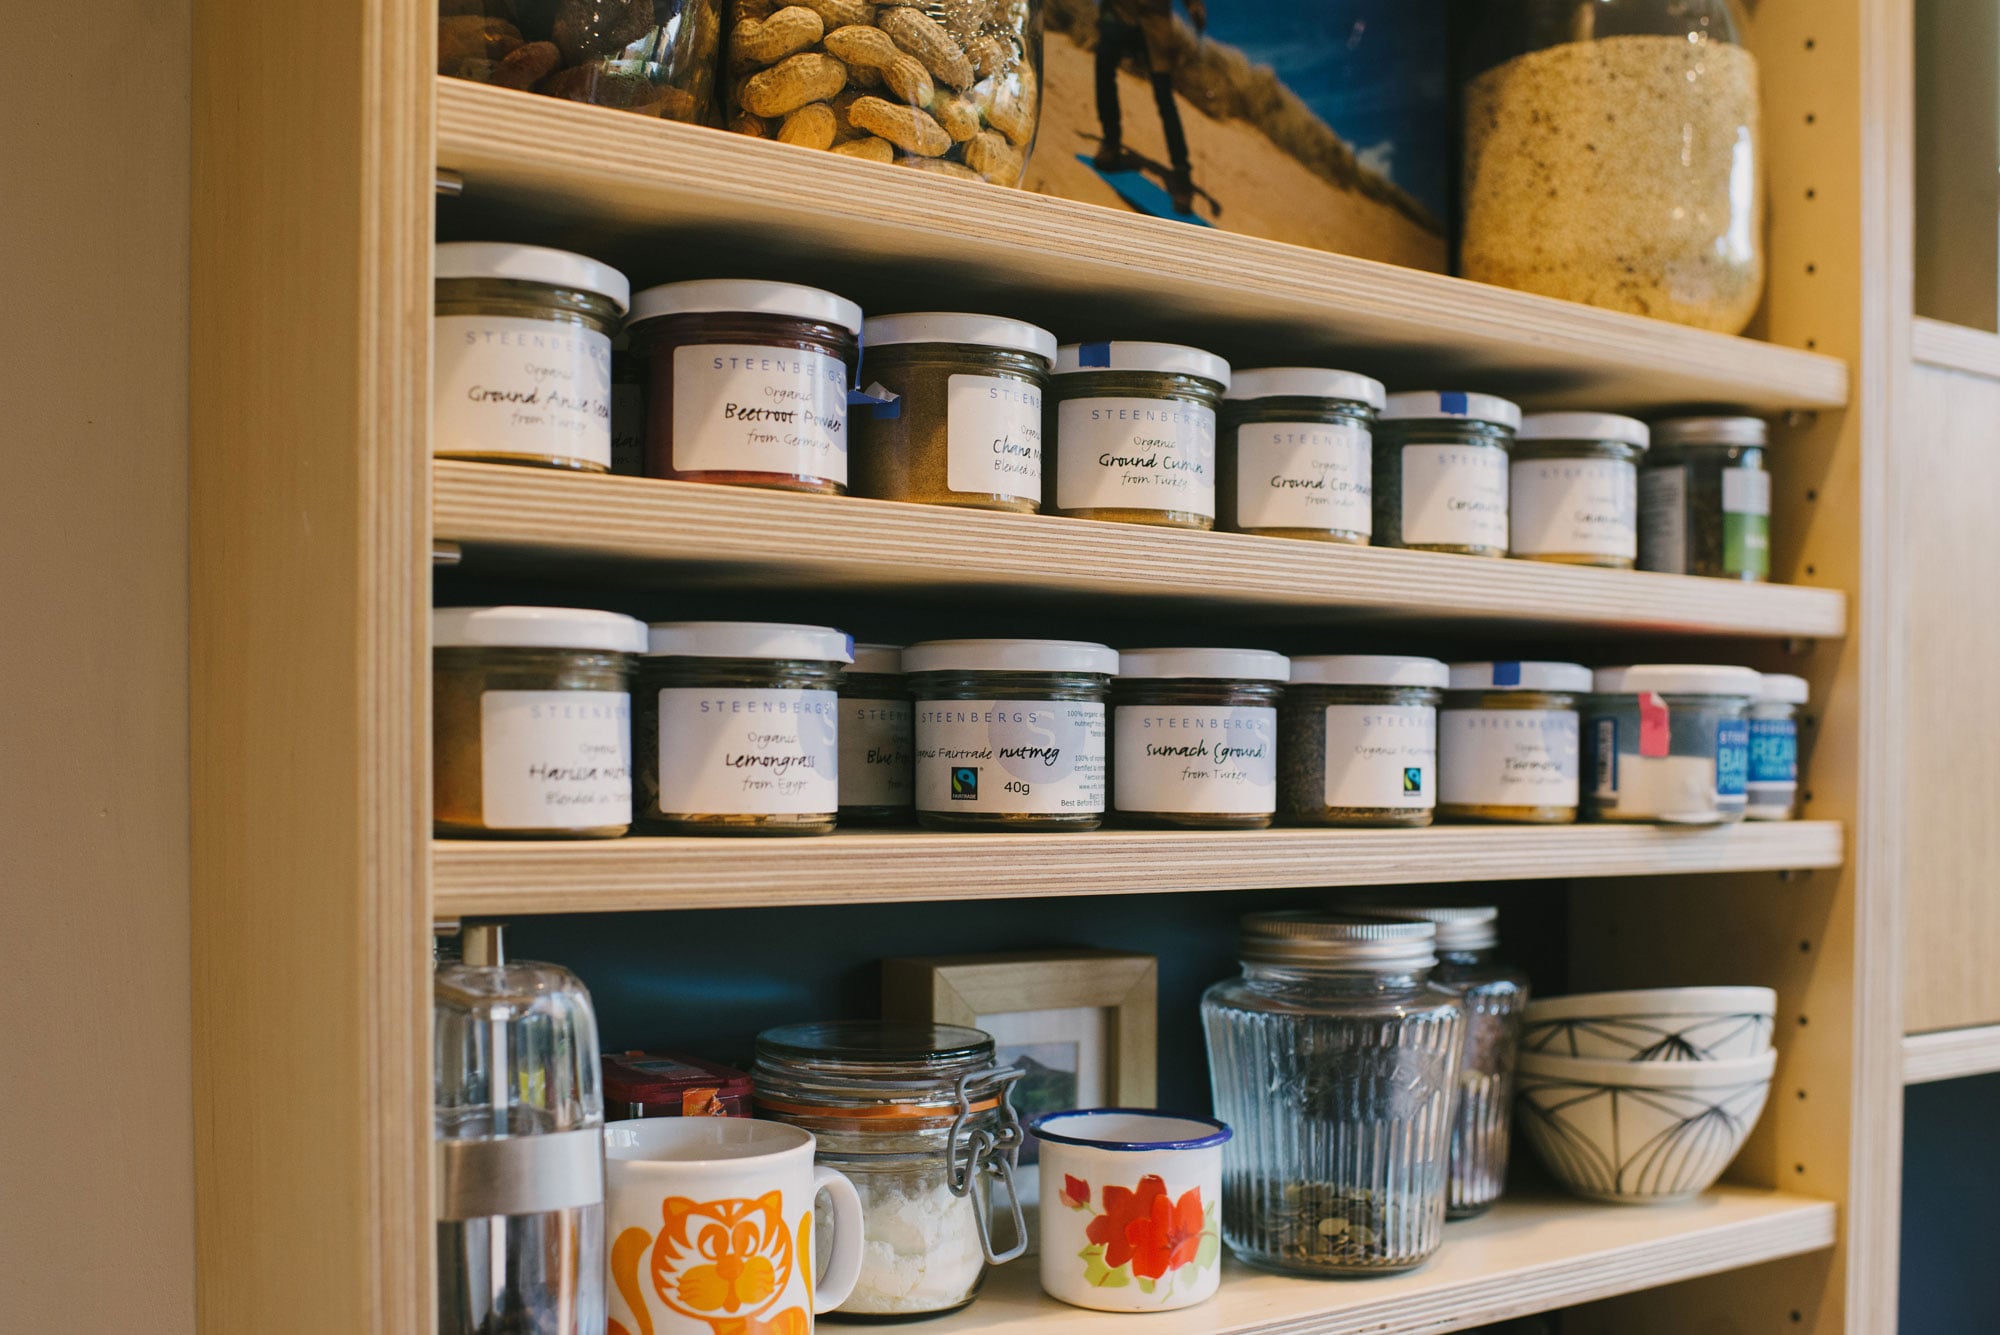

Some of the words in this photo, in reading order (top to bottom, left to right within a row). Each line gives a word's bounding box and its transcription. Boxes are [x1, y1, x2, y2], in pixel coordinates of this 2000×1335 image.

[713, 357, 842, 384] STEENBEGS
[468, 385, 538, 404] Ground
[764, 385, 813, 404] Organic
[511, 409, 544, 426] from
[725, 403, 798, 424] Beetroot
[803, 410, 842, 433] Powder
[747, 429, 779, 445] from
[1133, 436, 1176, 450] Organic
[993, 435, 1031, 458] Chana
[1099, 453, 1158, 468] Ground
[1163, 456, 1204, 474] Cumin
[1121, 471, 1150, 485] from
[1154, 474, 1188, 491] Turkey
[1271, 475, 1325, 489] Ground
[1305, 493, 1329, 507] from
[701, 700, 832, 715] STEENBERGS
[922, 712, 1037, 723] STEENBERGS
[1143, 718, 1263, 729] STEENBERGS
[747, 732, 797, 749] Organic
[725, 753, 815, 775] Lemongrass
[866, 747, 893, 765] Blue
[938, 746, 993, 760] Fairtrade
[998, 746, 1060, 766] nutmeg
[742, 777, 774, 791] from
[1182, 766, 1210, 780] from
[1214, 769, 1247, 785] Turkey
[1004, 781, 1030, 796] 40g
[1061, 799, 1075, 807] Best
